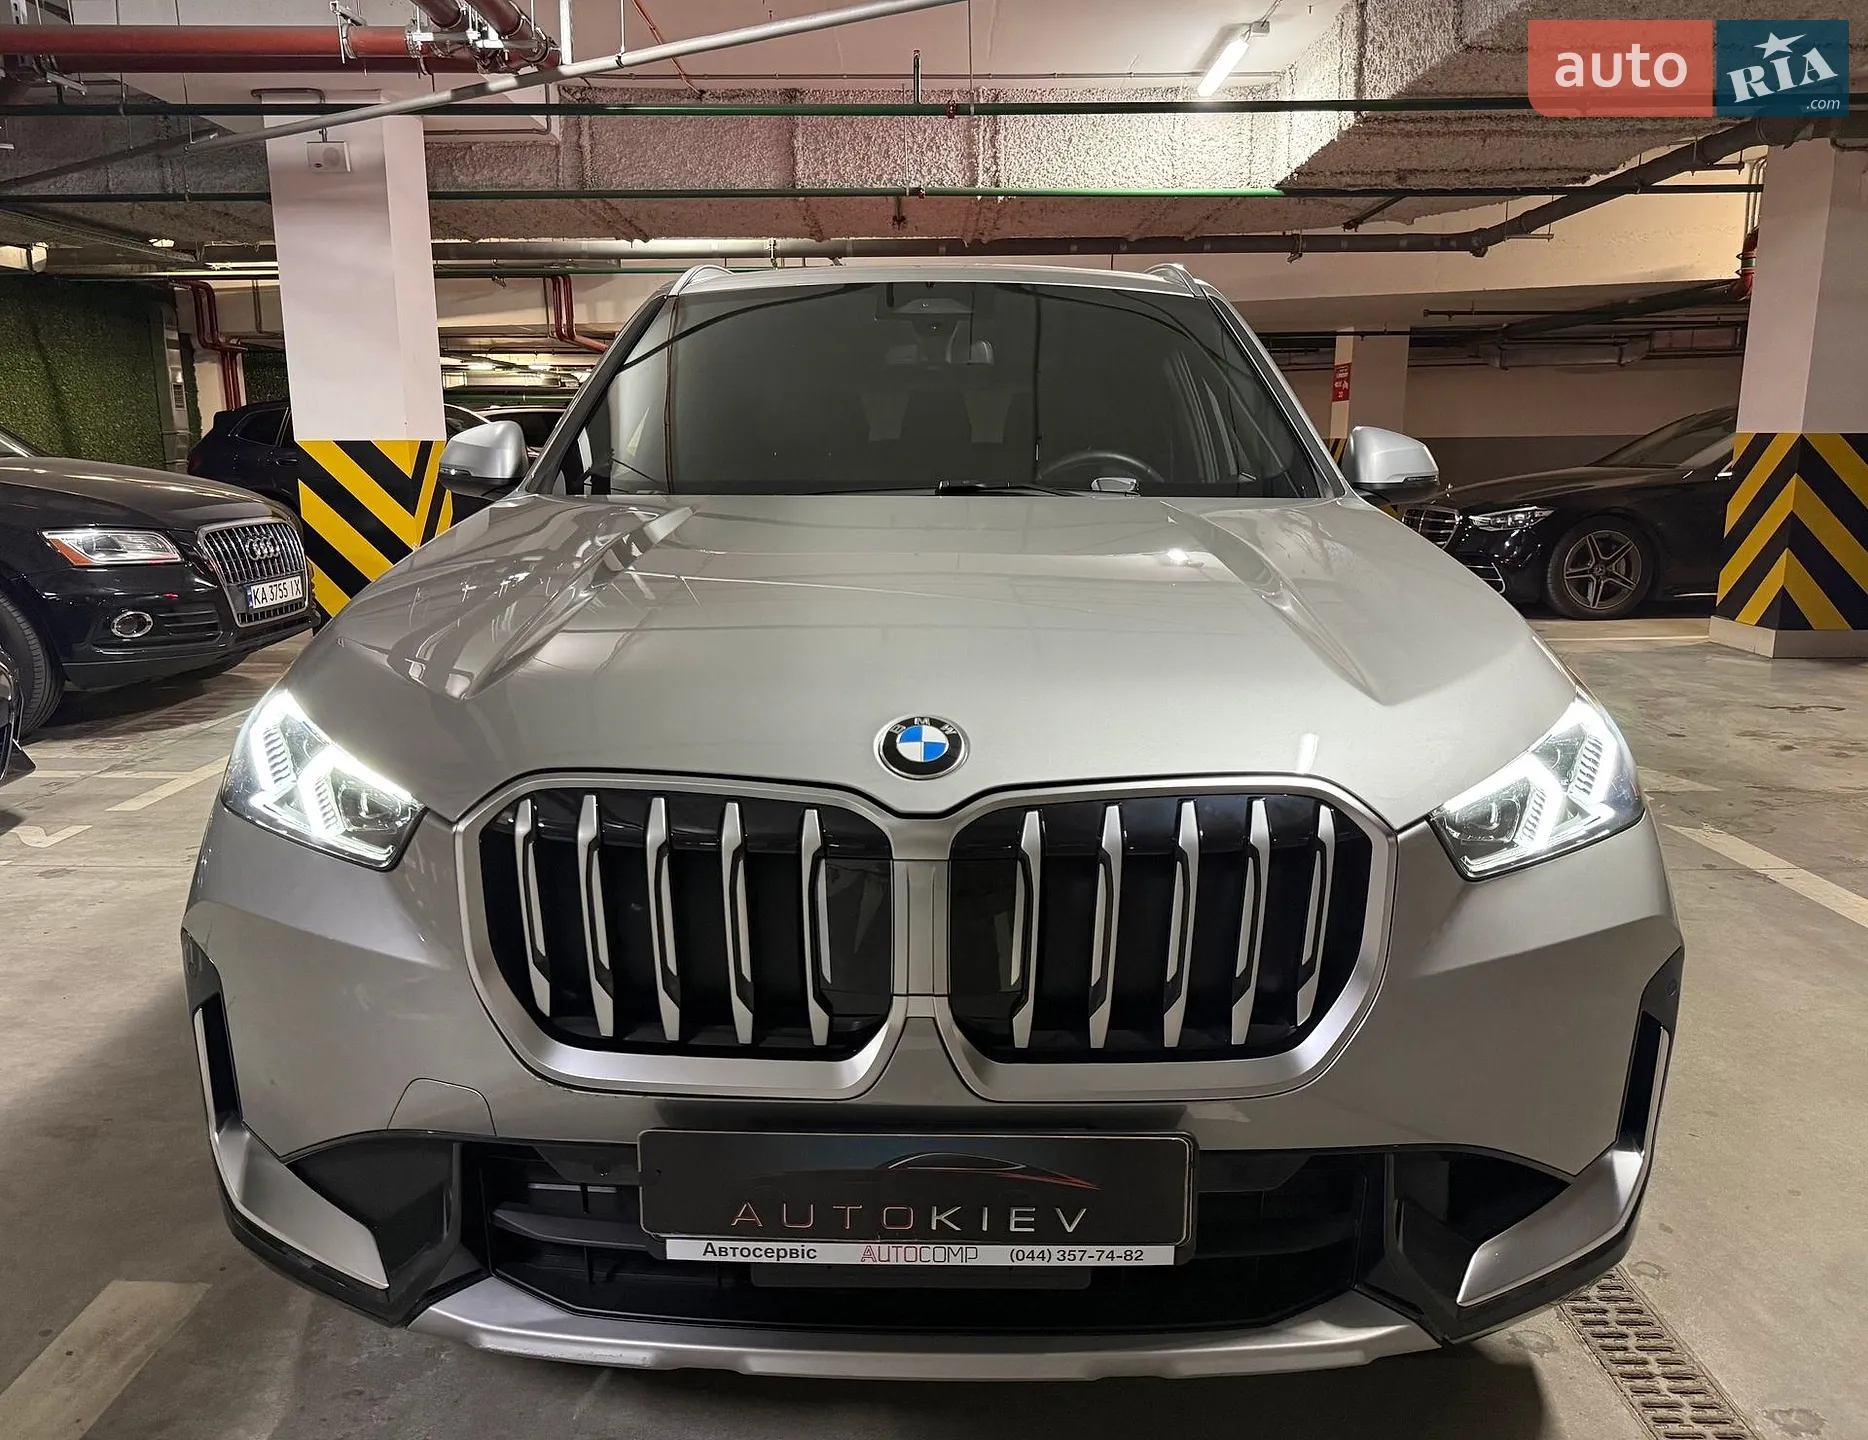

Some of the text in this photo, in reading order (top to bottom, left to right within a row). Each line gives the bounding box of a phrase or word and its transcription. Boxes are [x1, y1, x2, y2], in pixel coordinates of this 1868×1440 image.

[252, 579, 302, 606] KA 3755 IX
[888, 717, 958, 735] BMW
[730, 1202, 1088, 1233] AUTOKIEV
[702, 1241, 1144, 1264] Автосервіс AUTOCOMP (044) 357-74-82
